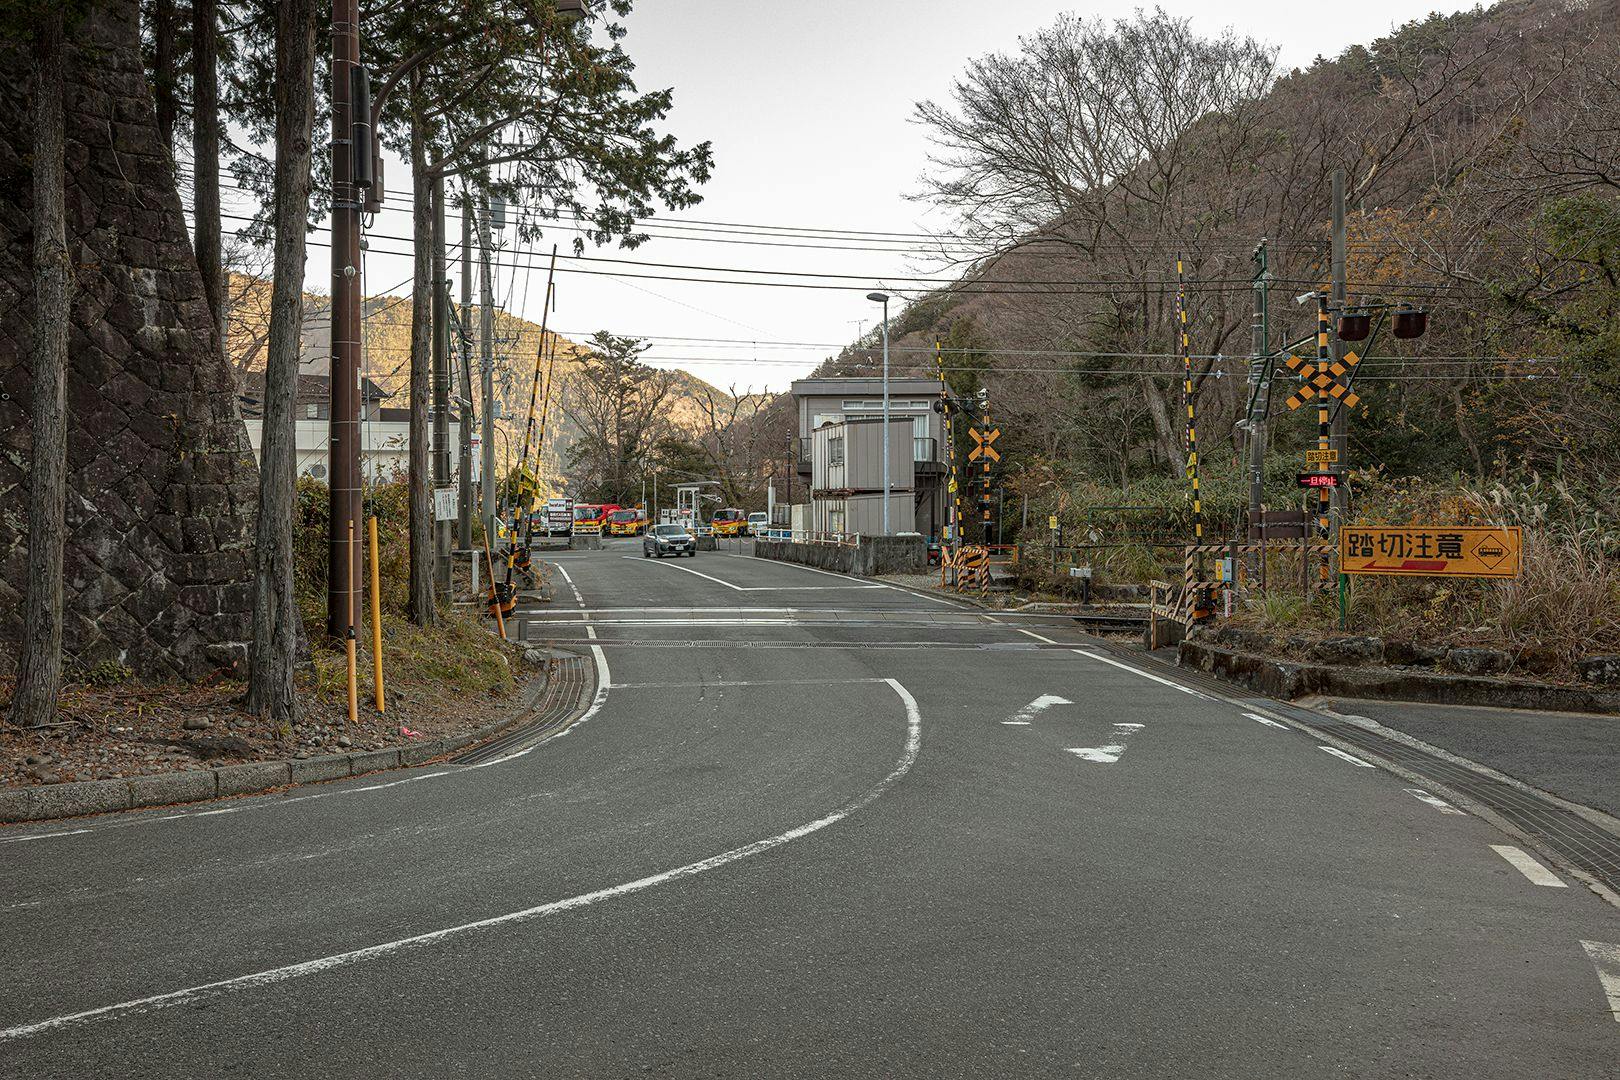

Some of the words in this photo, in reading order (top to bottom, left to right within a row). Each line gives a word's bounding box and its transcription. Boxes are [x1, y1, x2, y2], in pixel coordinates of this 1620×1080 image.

[1307, 451, 1337, 461] 踏切注意
[1300, 476, 1338, 486] 一旦停止
[1348, 532, 1465, 560] 踏切注意
